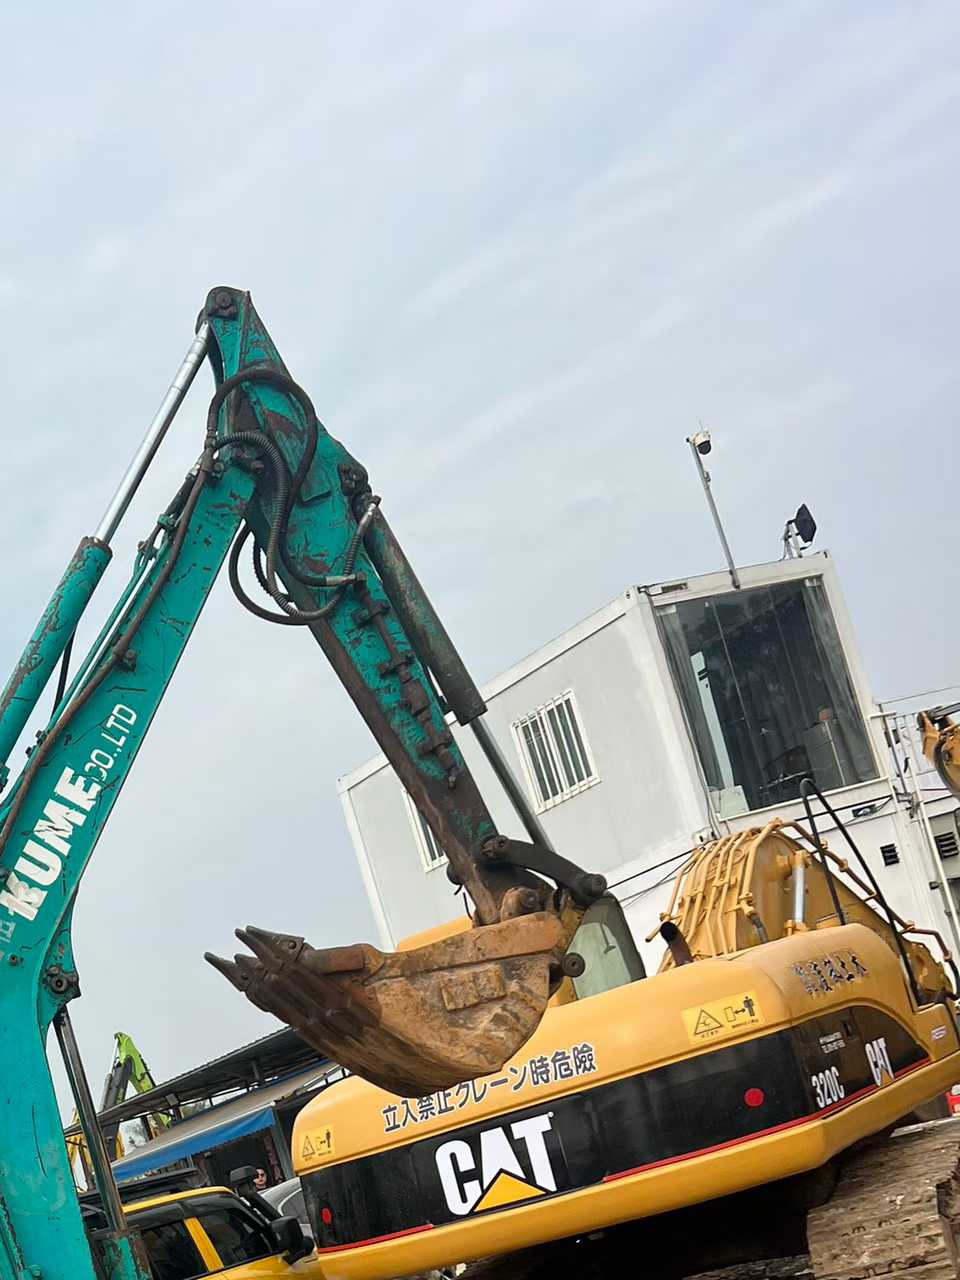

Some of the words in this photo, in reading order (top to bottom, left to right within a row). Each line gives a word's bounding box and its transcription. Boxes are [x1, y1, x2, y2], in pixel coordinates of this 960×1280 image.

[811, 1065, 845, 1109] 320C
[865, 1037, 895, 1087] CAT
[435, 1112, 558, 1215] CAT
